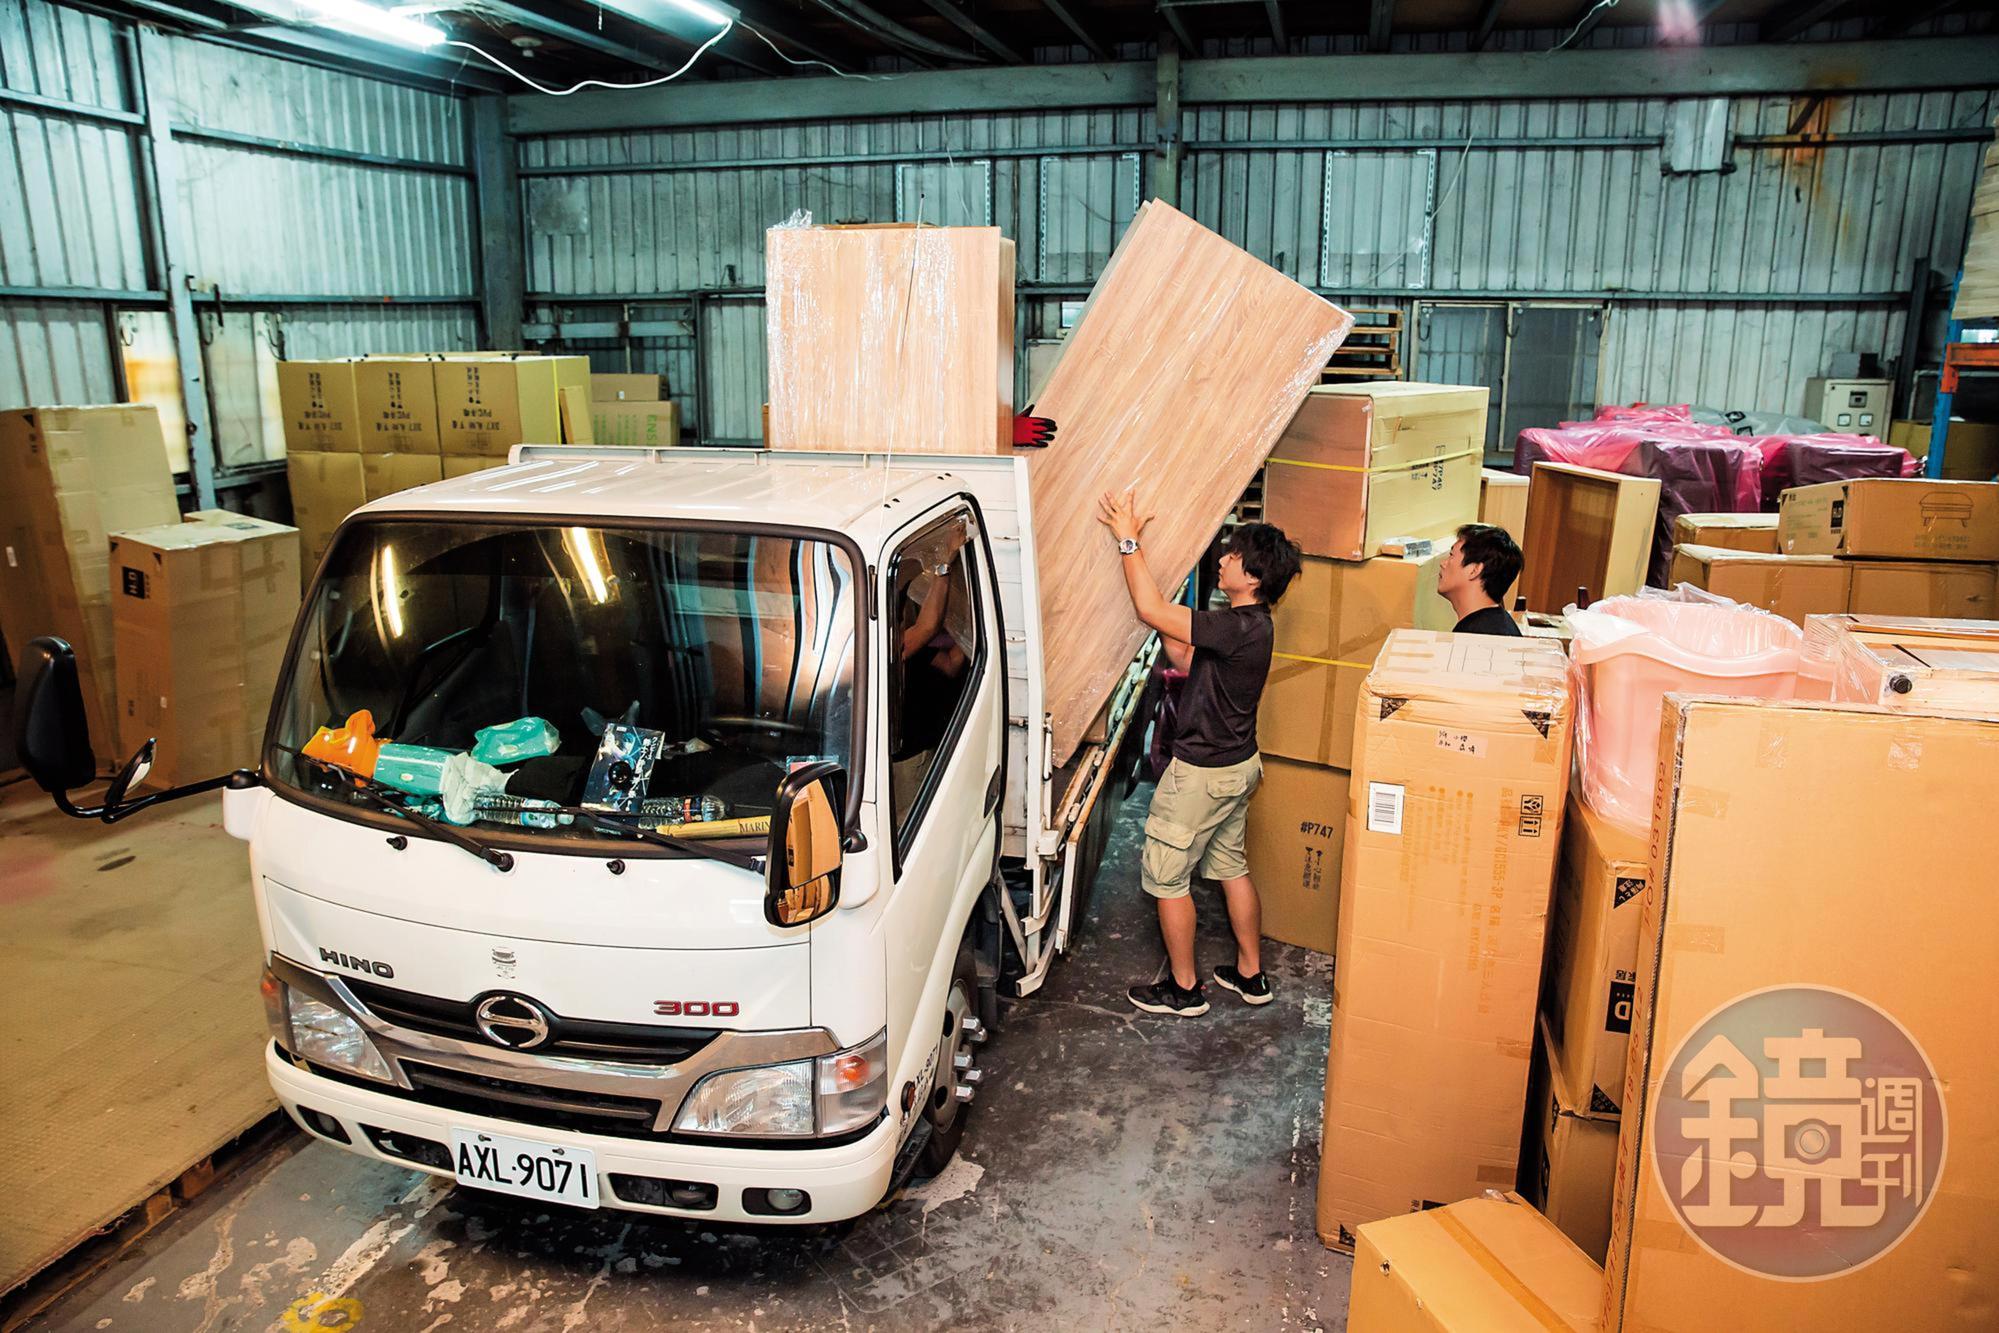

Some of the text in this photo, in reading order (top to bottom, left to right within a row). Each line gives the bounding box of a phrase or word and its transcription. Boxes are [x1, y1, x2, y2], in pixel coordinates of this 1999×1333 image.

[1299, 821, 1333, 839] #P747
[319, 947, 395, 979] HINO
[654, 1000, 740, 1017] 300
